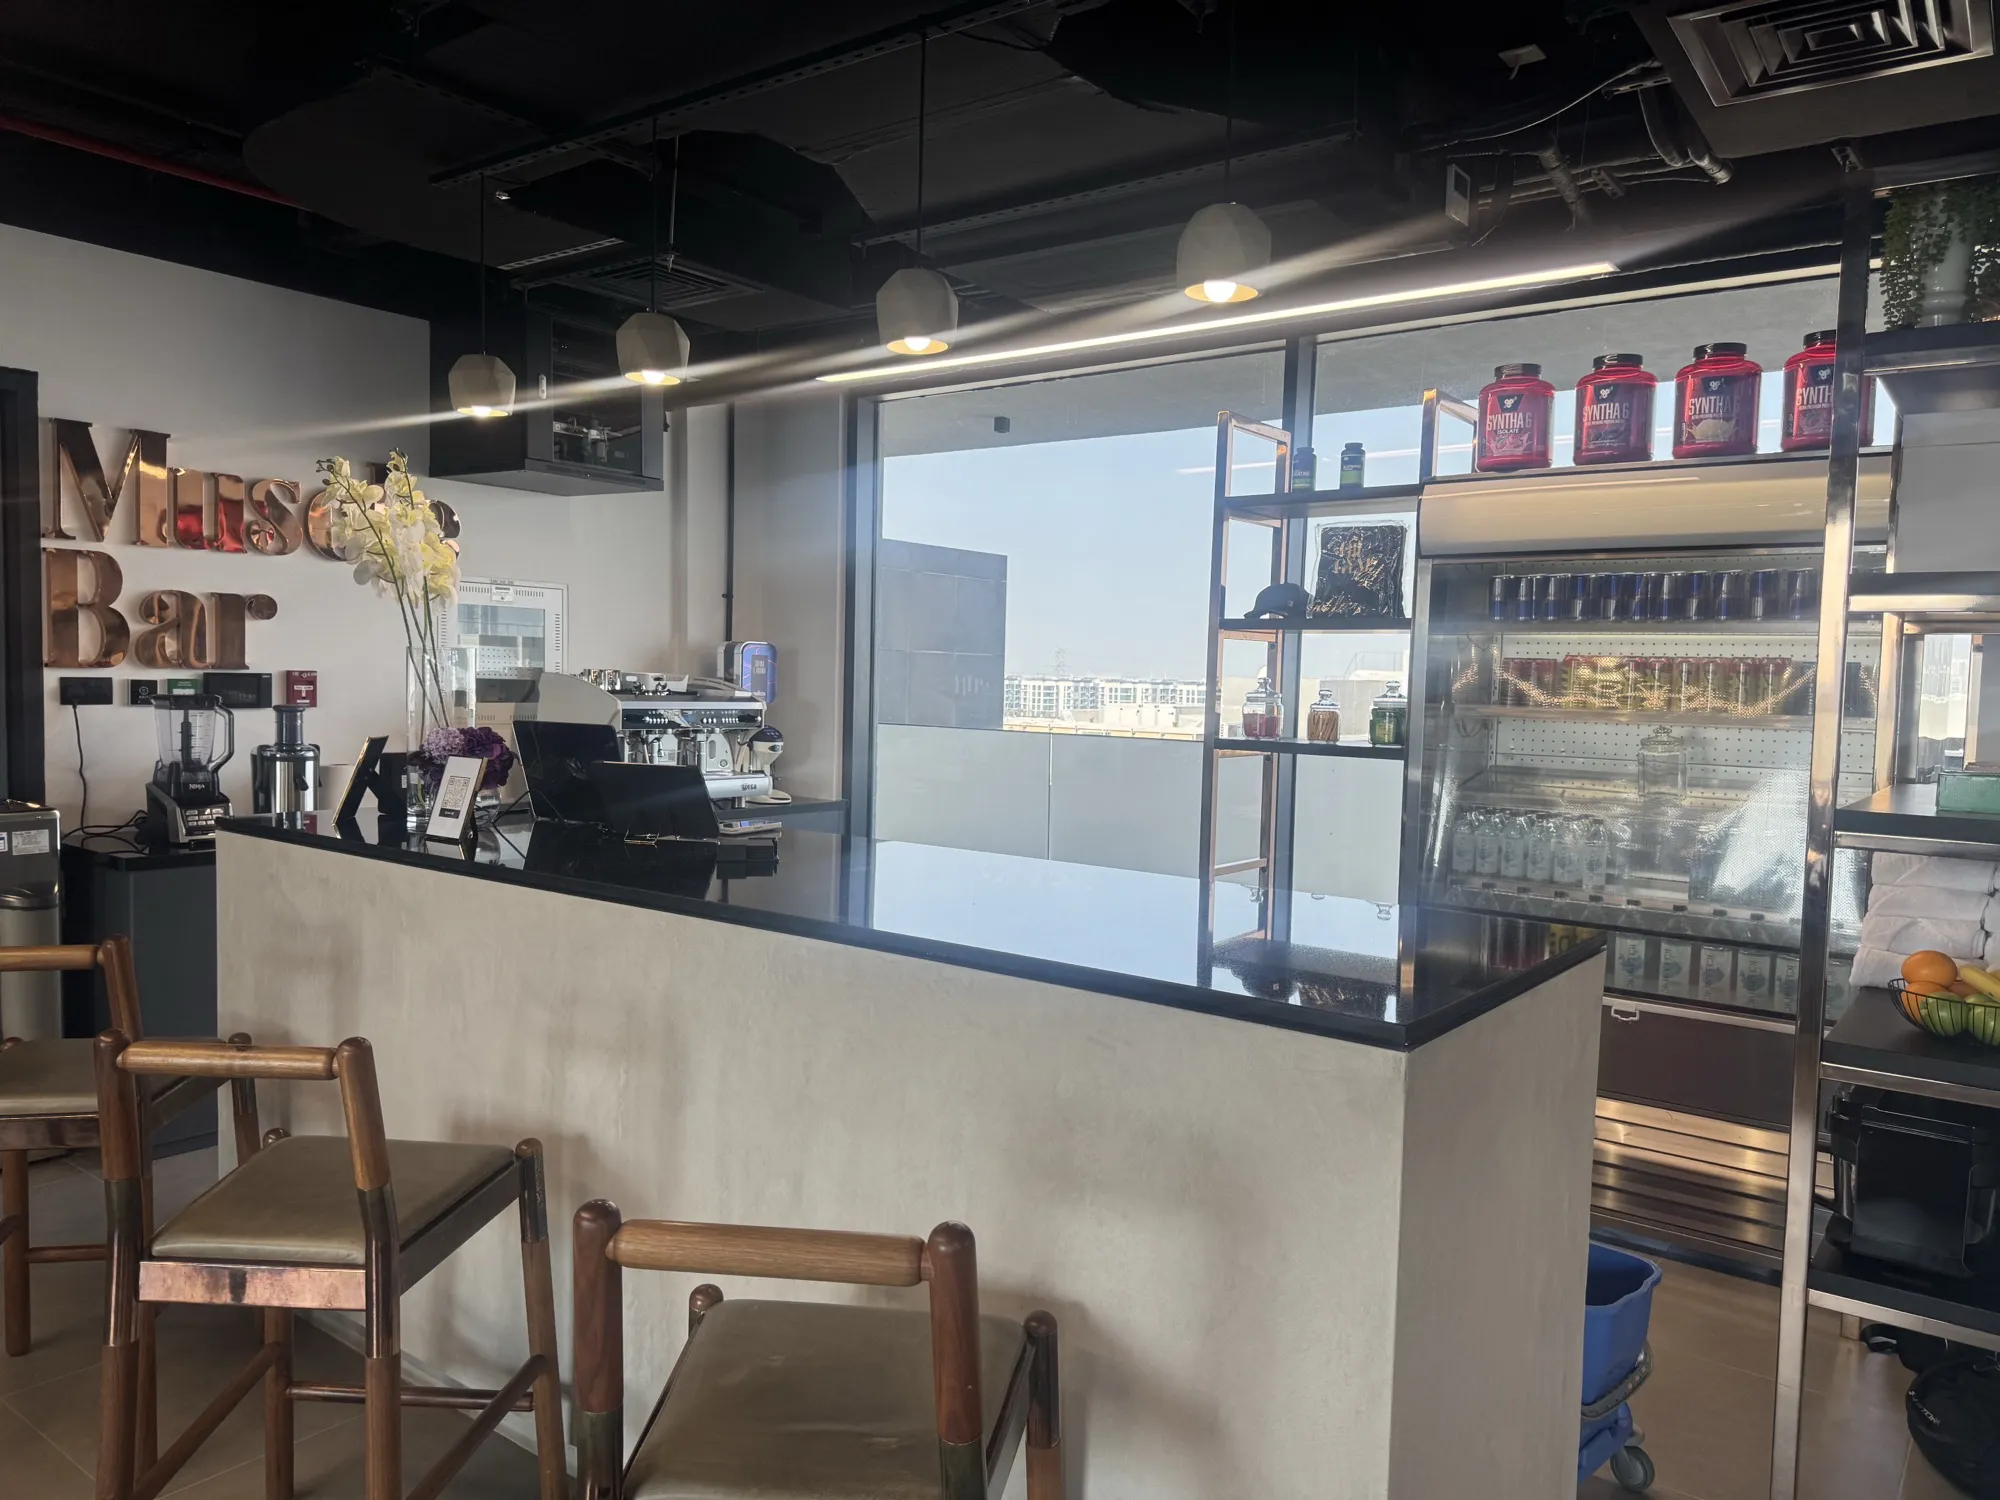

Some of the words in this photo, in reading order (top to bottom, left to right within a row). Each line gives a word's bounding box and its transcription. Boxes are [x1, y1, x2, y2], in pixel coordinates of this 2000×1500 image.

[1583, 403, 1621, 423] SYNTHA
[1622, 402, 1630, 419] 6
[1689, 395, 1732, 415] SYNTHA
[1487, 412, 1524, 431] SYNTHA
[1525, 412, 1533, 428] 6
[43, 547, 279, 670] Bar
